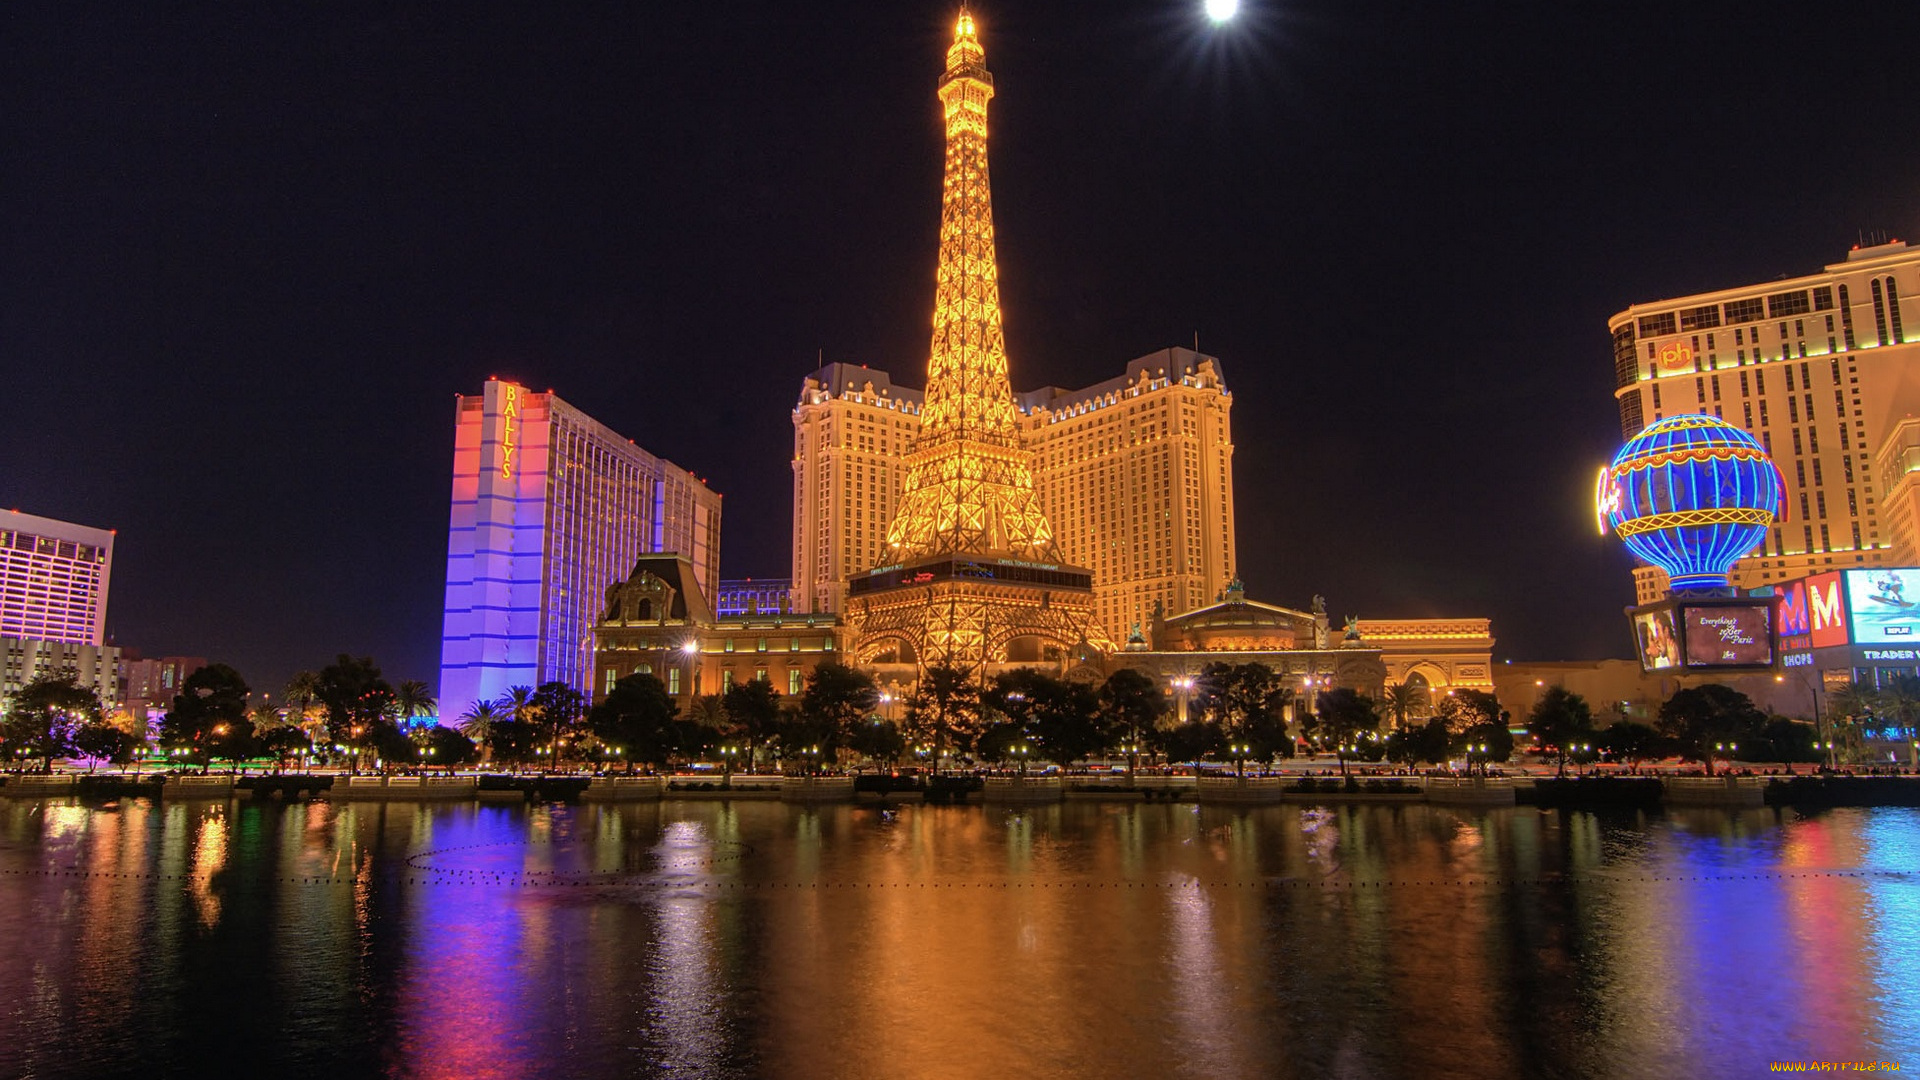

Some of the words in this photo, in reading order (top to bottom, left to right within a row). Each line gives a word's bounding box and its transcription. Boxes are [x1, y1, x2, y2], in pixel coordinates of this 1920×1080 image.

[1662, 343, 1691, 366] ph
[1810, 581, 1842, 630] M
[1783, 652, 1813, 667] SHOPS
[1864, 650, 1915, 660] TRADER
